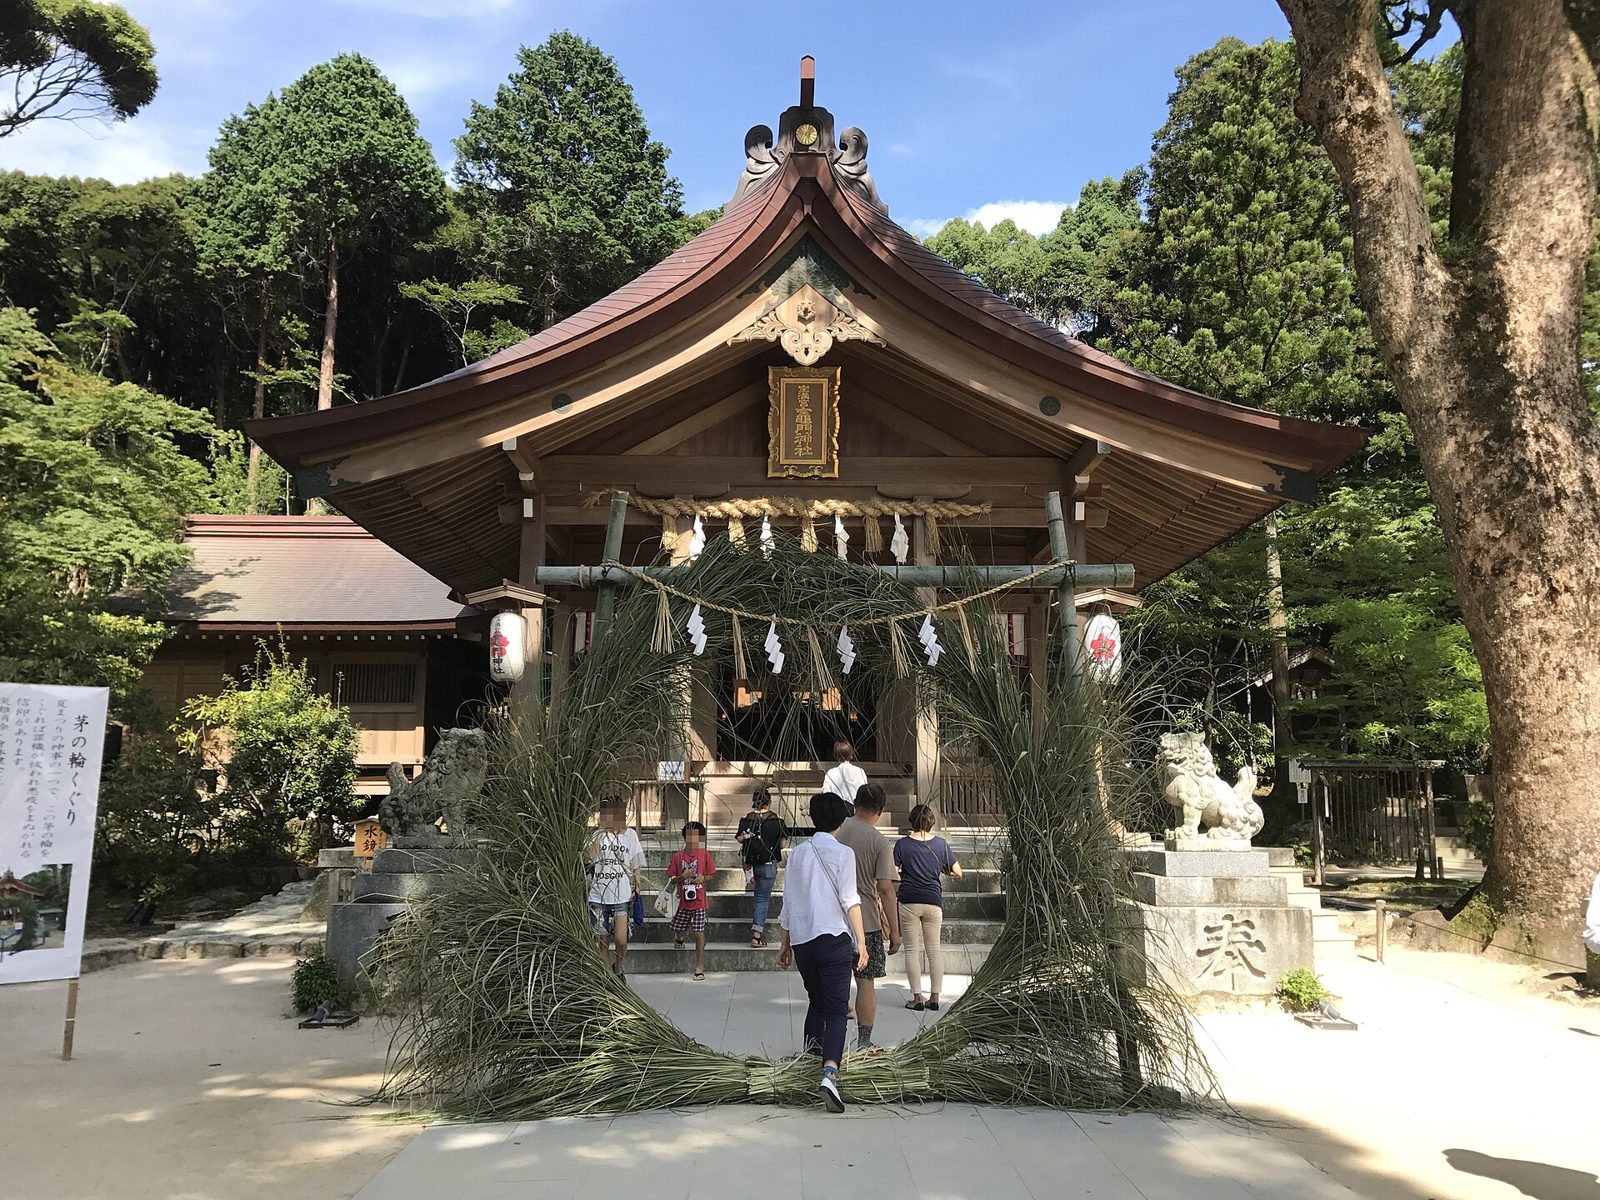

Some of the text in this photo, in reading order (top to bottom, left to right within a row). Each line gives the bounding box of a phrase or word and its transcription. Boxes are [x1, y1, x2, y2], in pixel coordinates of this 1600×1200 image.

[66, 714, 90, 827] 茅の輪くぐり
[1196, 913, 1267, 991] 奉
